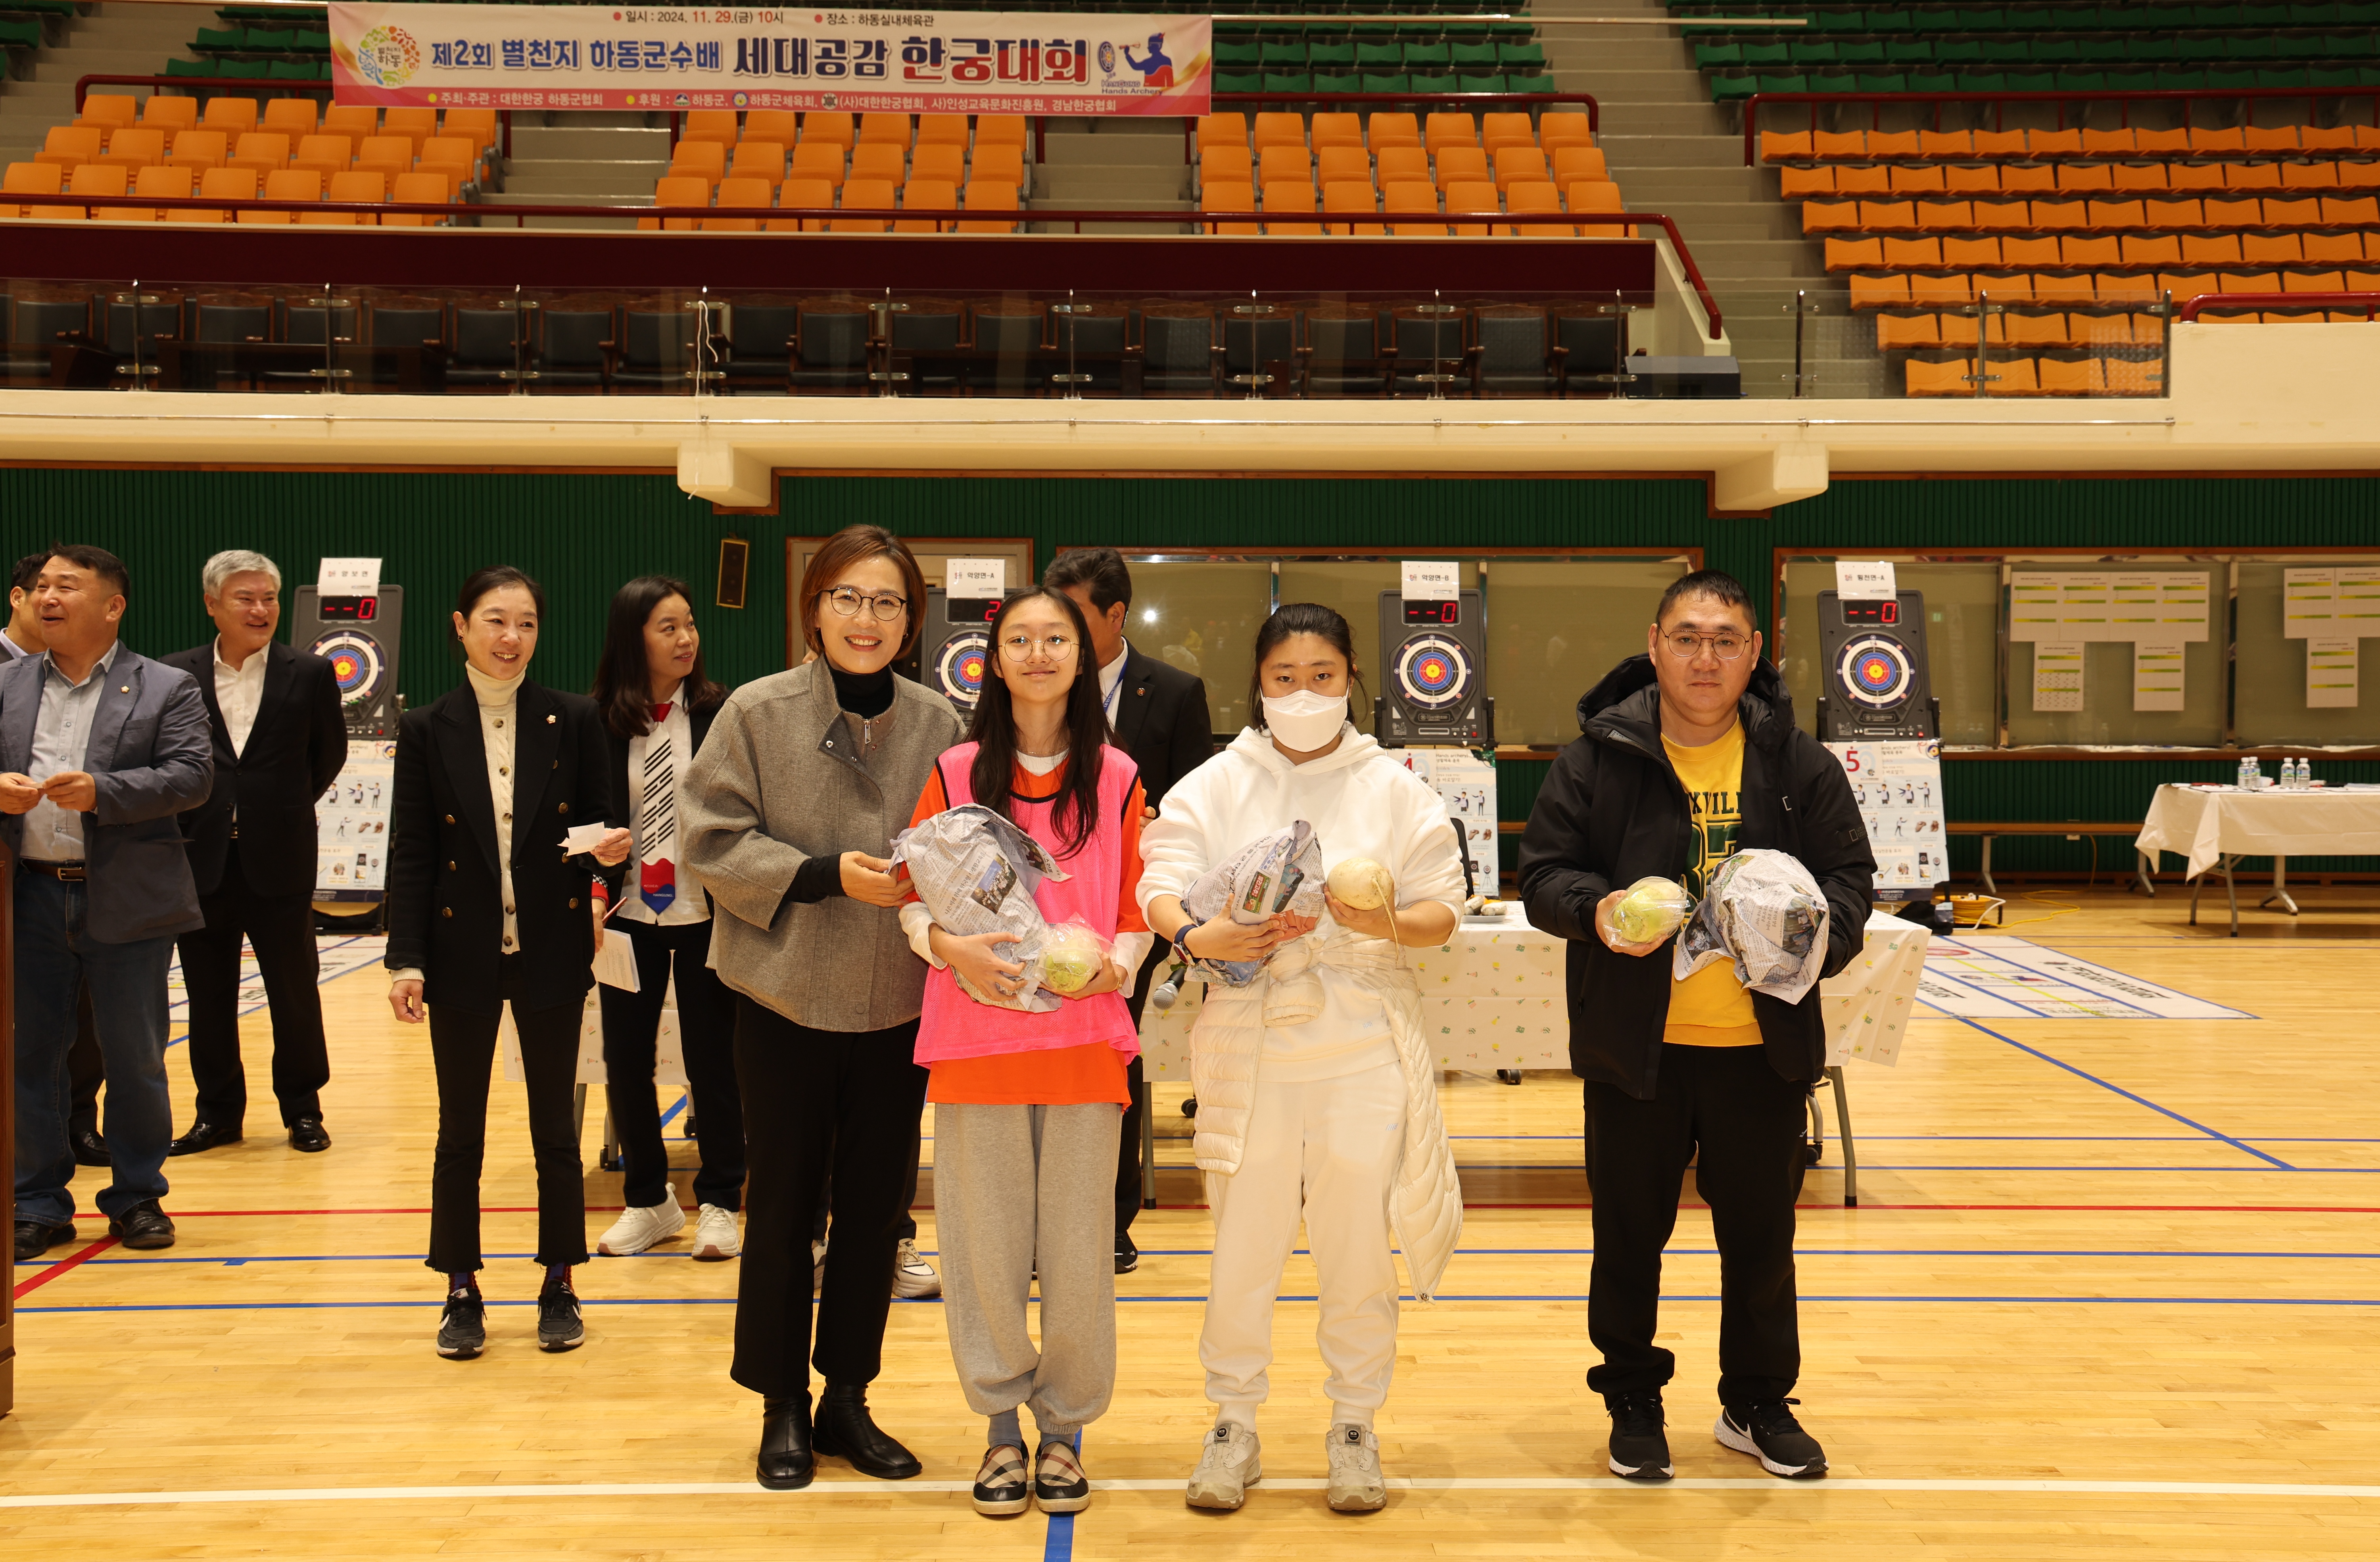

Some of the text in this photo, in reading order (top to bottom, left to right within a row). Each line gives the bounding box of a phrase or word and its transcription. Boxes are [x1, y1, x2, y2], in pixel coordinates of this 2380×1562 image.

[626, 12, 647, 22] 일시
[658, 12, 688, 23] 2024.
[693, 12, 710, 23] 11.
[758, 12, 784, 24] 10시
[827, 14, 848, 25] 장소
[858, 14, 934, 27] 하동실내체육관
[432, 36, 1086, 82] 제2회 별천지 하동군수배 세대공감 한궁대회
[500, 92, 544, 105] 대한한궁
[548, 93, 603, 106] 하동군협회
[638, 93, 661, 106] 후원
[692, 94, 728, 107] 하동군,
[1052, 99, 1116, 111] 경남한궁협회
[984, 601, 1001, 621] 2
[1846, 750, 1860, 772] 5
